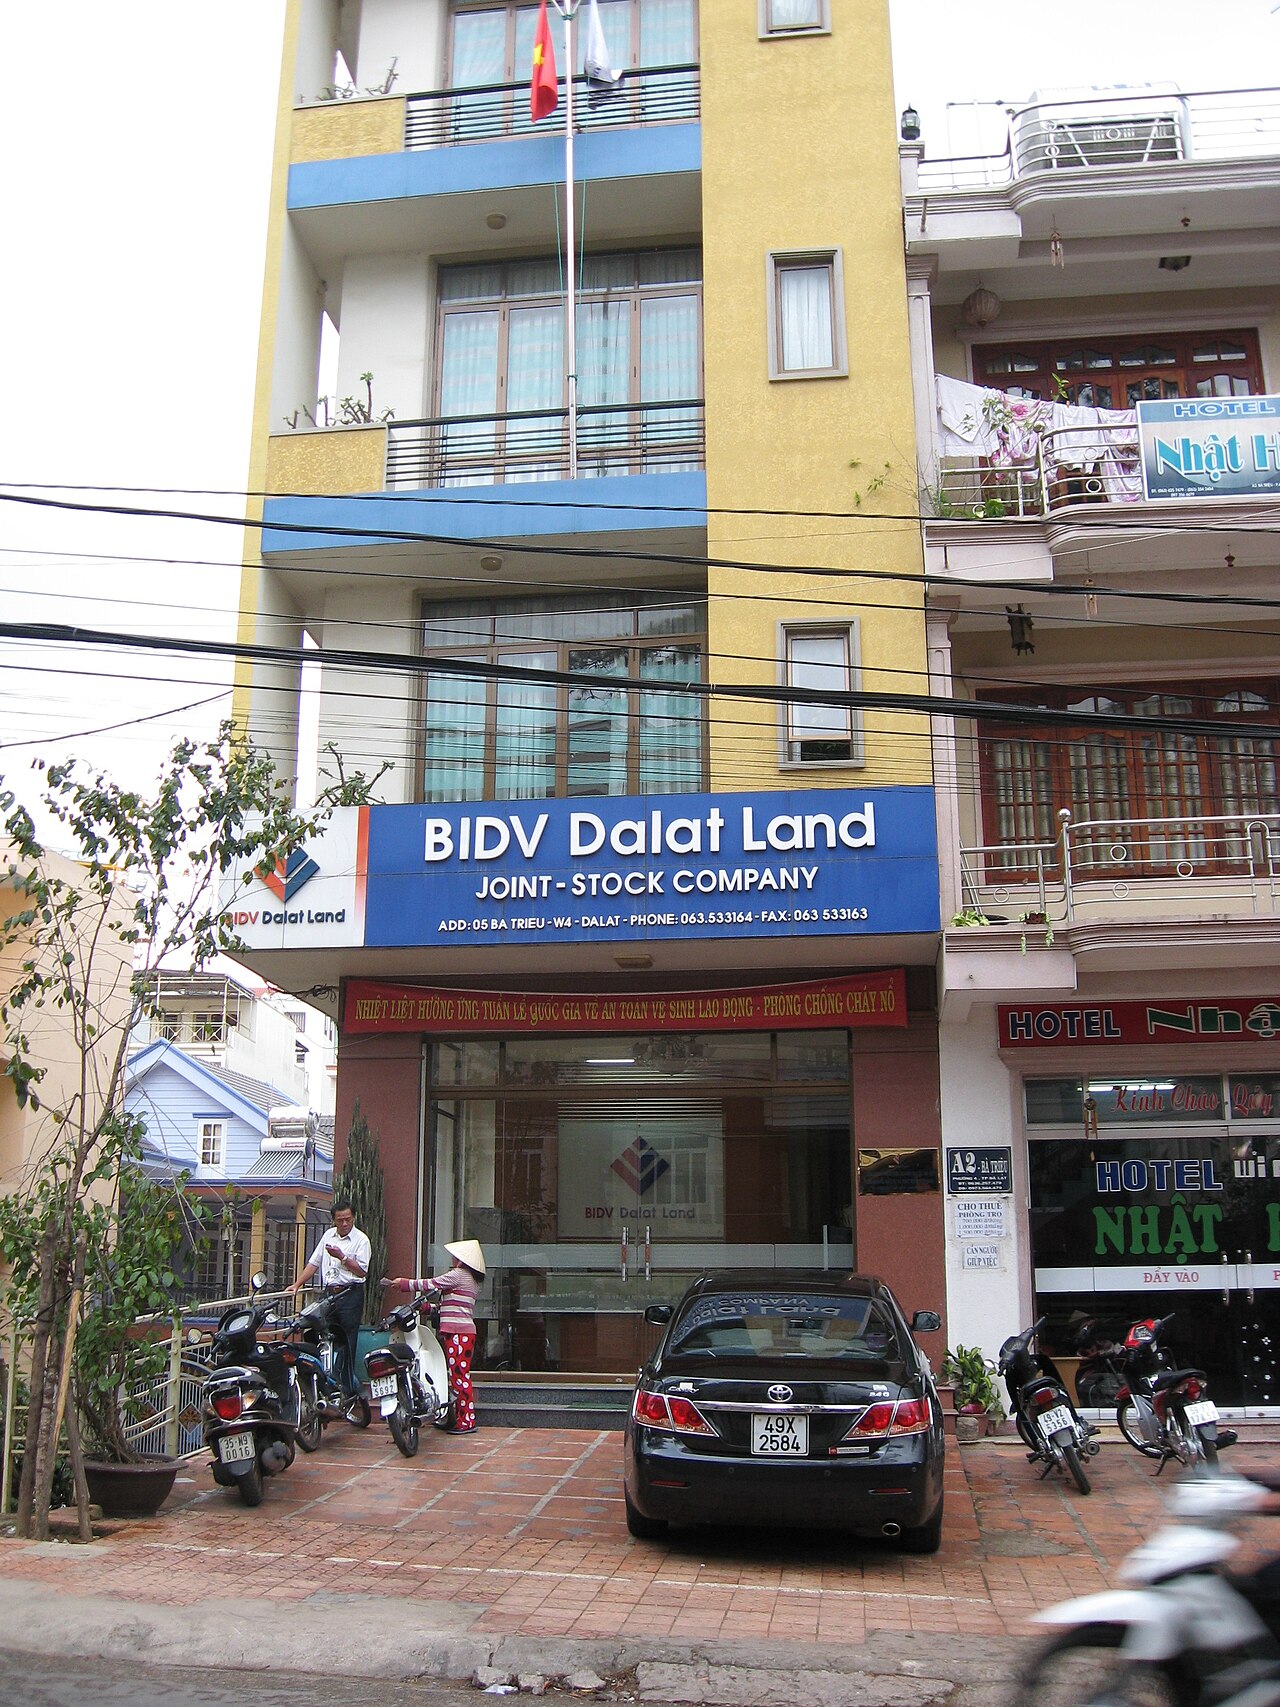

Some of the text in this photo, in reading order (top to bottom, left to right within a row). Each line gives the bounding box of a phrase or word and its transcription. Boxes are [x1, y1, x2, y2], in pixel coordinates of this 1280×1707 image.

[1174, 400, 1276, 418] HOTEL
[1154, 432, 1245, 482] Nhật
[424, 801, 876, 863] BIDV Dalat Land
[475, 875, 553, 900] JOINT
[571, 871, 665, 897] STOCK
[672, 866, 820, 894] COMPANY
[262, 909, 304, 925] Dalat
[307, 908, 346, 924] Land
[491, 918, 508, 931] BA
[511, 917, 545, 929] TRIEU
[581, 915, 621, 928] DALAT
[630, 913, 679, 926] PHONE:
[680, 910, 753, 925] 063.533164
[761, 909, 792, 923] FAX:
[793, 909, 819, 922] 063
[822, 907, 868, 921] 533163
[355, 995, 388, 1024] NHIỆT
[390, 994, 415, 1023] LIỆT
[562, 1002, 582, 1021] GIA
[601, 1001, 616, 1020] AN
[620, 998, 649, 1020] TOÀN
[669, 999, 696, 1019] SINH
[699, 998, 720, 1019] LAO
[763, 990, 801, 1017] PHÒNG
[804, 985, 843, 1015] CHỐNG
[846, 985, 878, 1013] CHÁY
[1008, 1009, 1122, 1040] HOTEL
[951, 1151, 977, 1173] A2
[1096, 1159, 1223, 1192] HOTEL
[585, 1206, 696, 1219] BIDV Dalat Land
[957, 1202, 977, 1211] CHO
[1091, 1192, 1224, 1264] NHẬT
[764, 1415, 796, 1434] 49X
[226, 1446, 250, 1461] 0016
[758, 1434, 801, 1452] 2584
